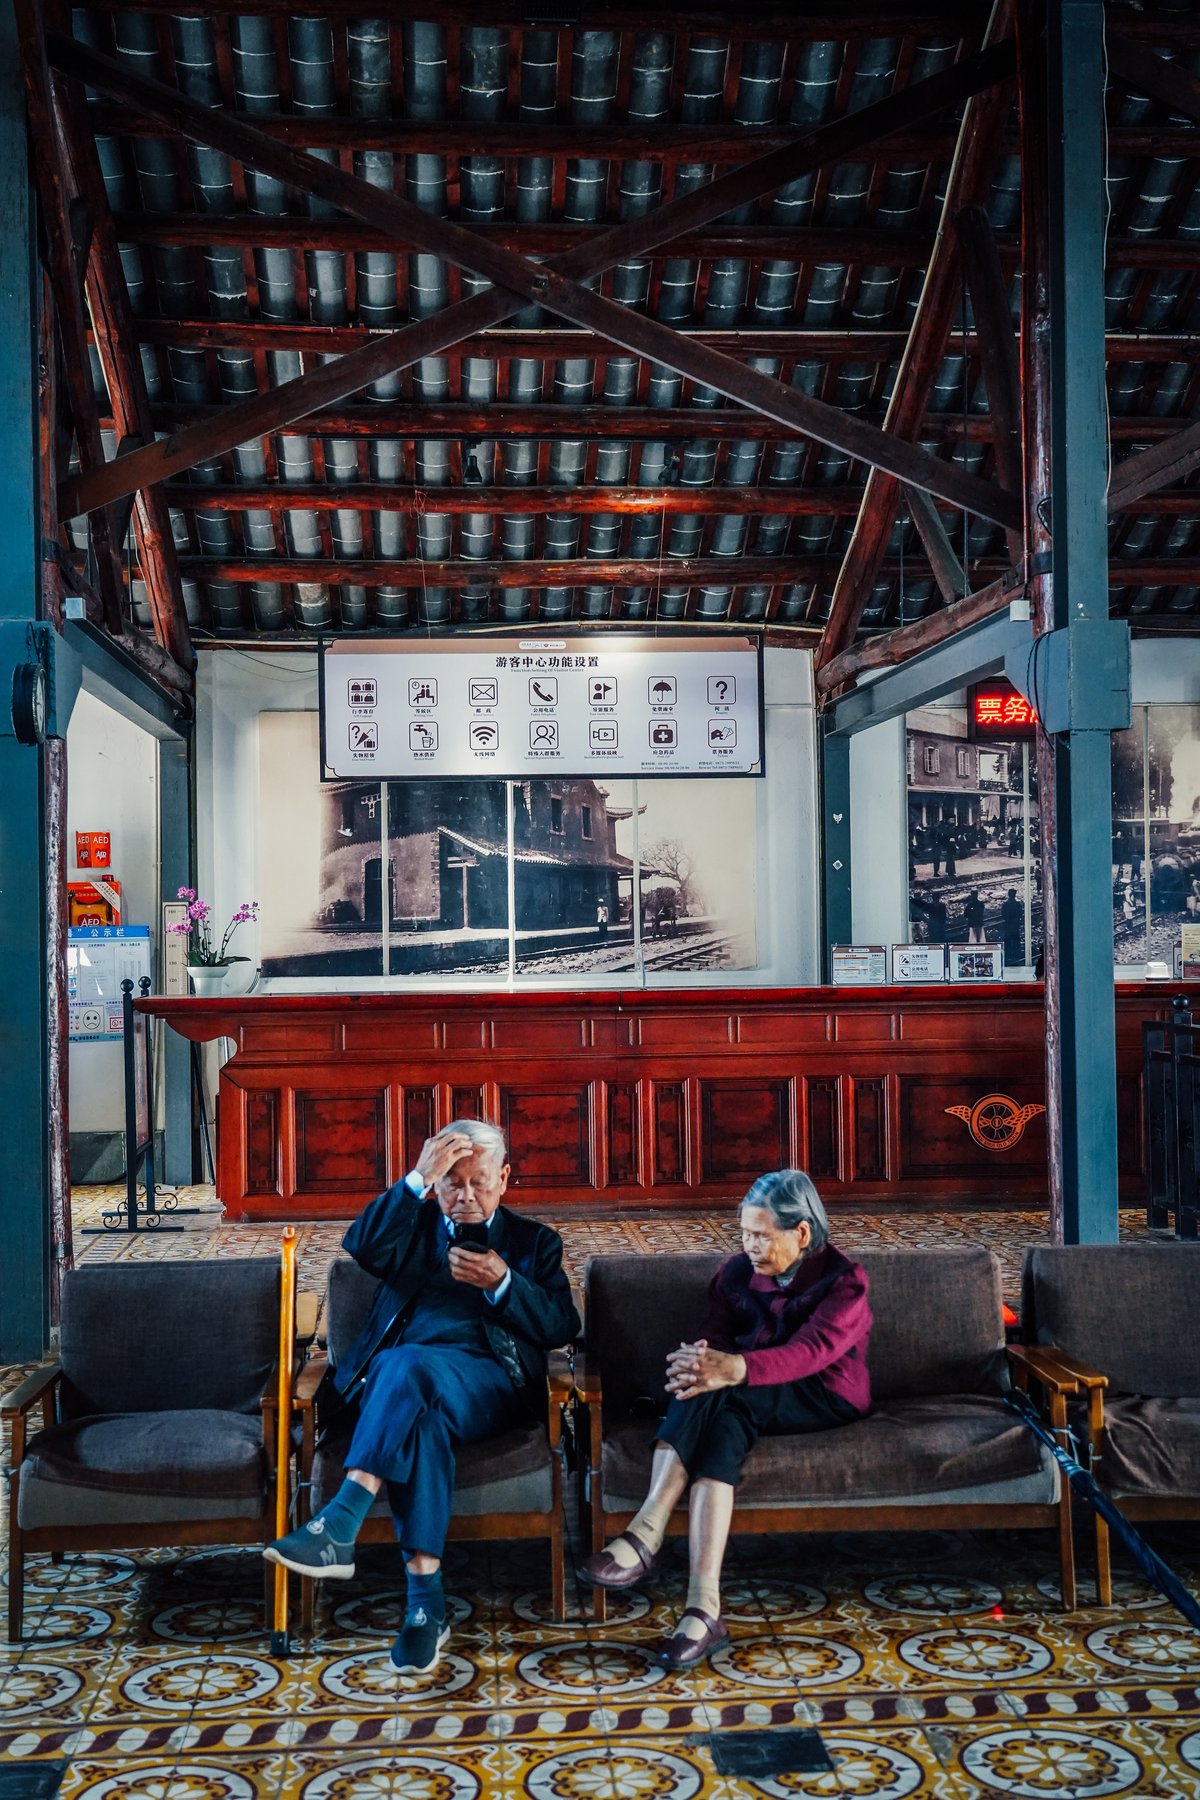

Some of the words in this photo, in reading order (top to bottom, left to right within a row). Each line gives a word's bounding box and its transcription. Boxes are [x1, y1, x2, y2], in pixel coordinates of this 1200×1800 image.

[495, 656, 599, 668] 游客中心功能设置
[77, 836, 90, 844] AED
[93, 836, 109, 844] AED
[80, 917, 100, 927] AED
